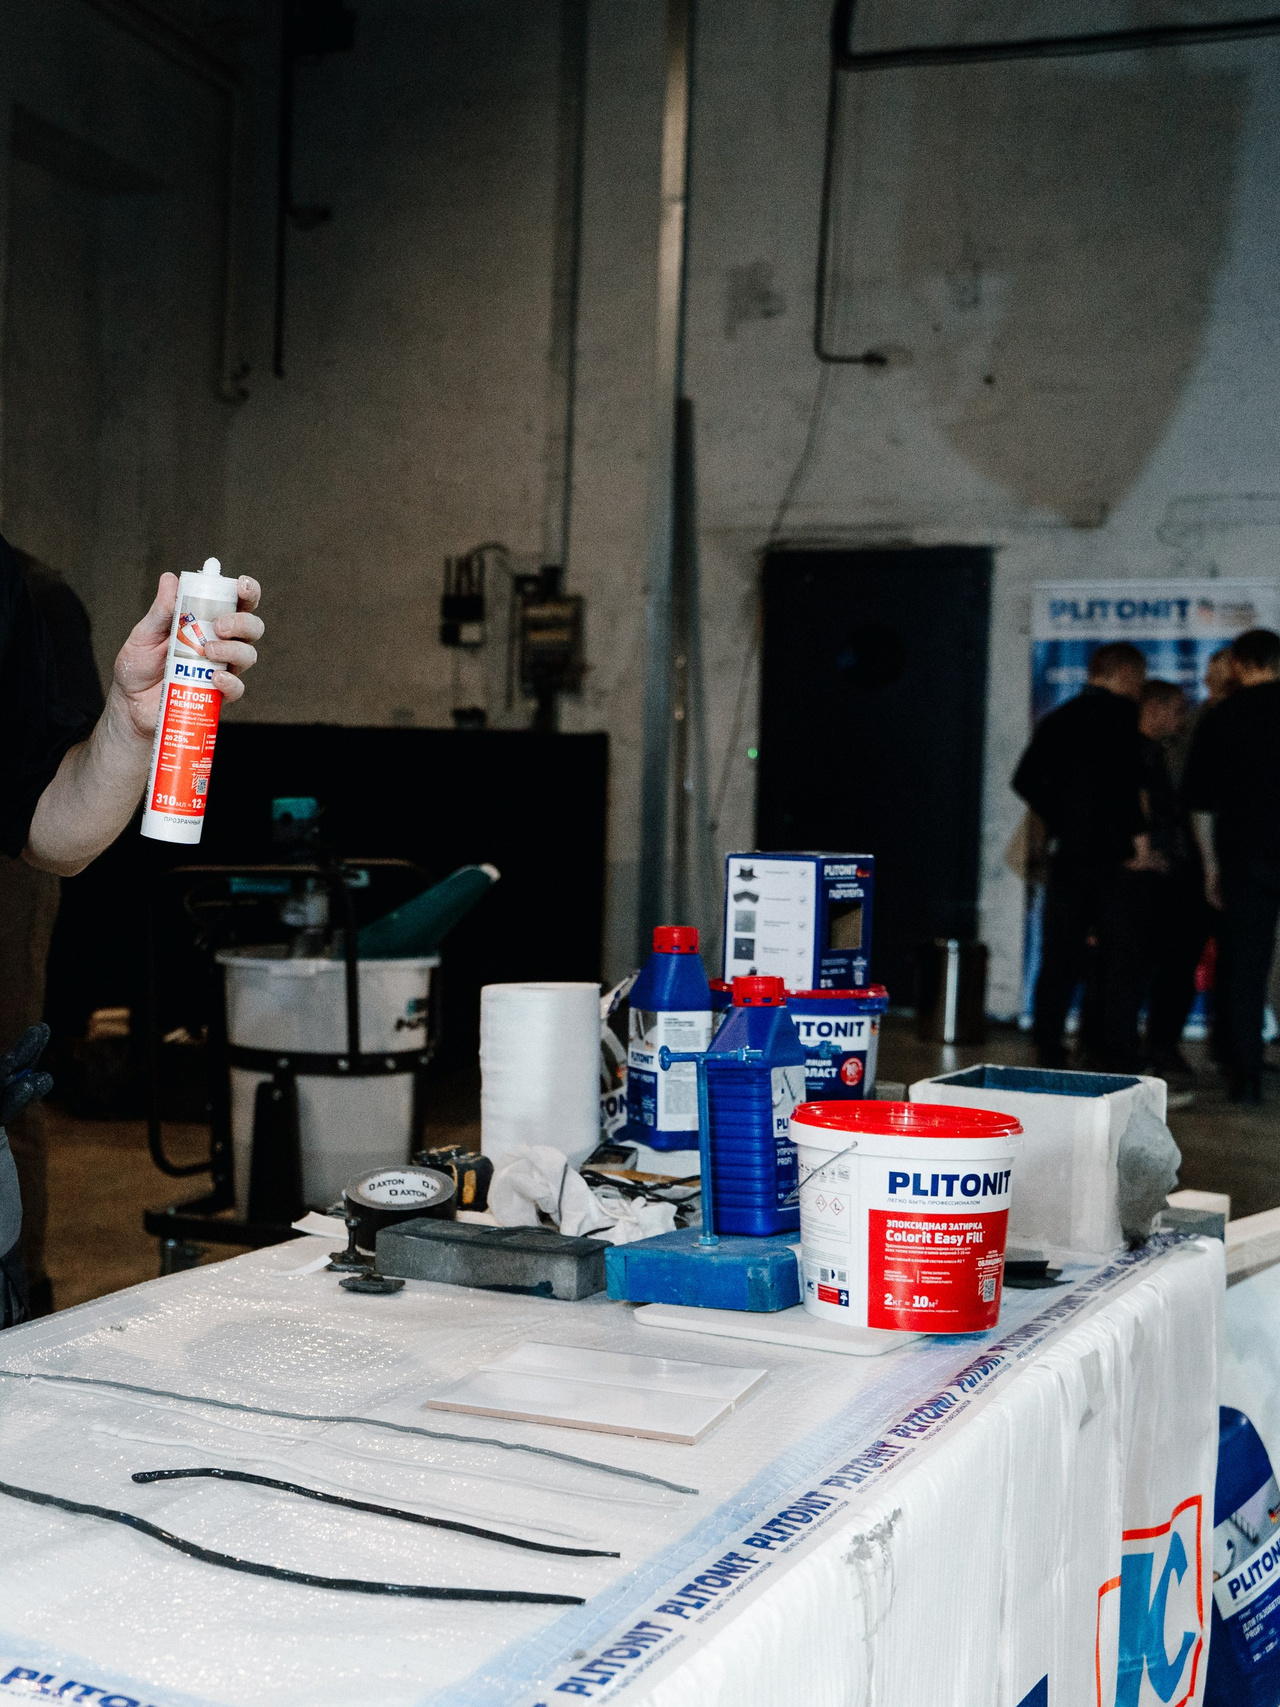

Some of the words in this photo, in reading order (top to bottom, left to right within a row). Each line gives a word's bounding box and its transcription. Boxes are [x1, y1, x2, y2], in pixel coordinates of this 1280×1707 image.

[1049, 597, 1190, 621] PLITONIT
[175, 663, 215, 680] PLITO
[169, 698, 205, 711] PREMIUM
[171, 688, 213, 704] PLITOSIL
[796, 1021, 865, 1038] ITONIT
[376, 1178, 405, 1189] AXTON
[400, 1188, 428, 1199] AXTON
[888, 1169, 1012, 1198] PLITONIT
[886, 1219, 948, 1231] ЭПОКСИДНАЯ
[948, 1221, 983, 1231] ЗАТИРКА
[885, 1229, 932, 1244] Colorit
[934, 1231, 964, 1247] Easy
[819, 1439, 905, 1491] PLITONIT
[741, 1490, 839, 1551] PLITONIT
[1227, 1536, 1280, 1601] PLITON
[653, 1550, 761, 1620] PLITONIT
[554, 1620, 674, 1698] PLITONIT
[0, 1666, 158, 1707] PLITO
